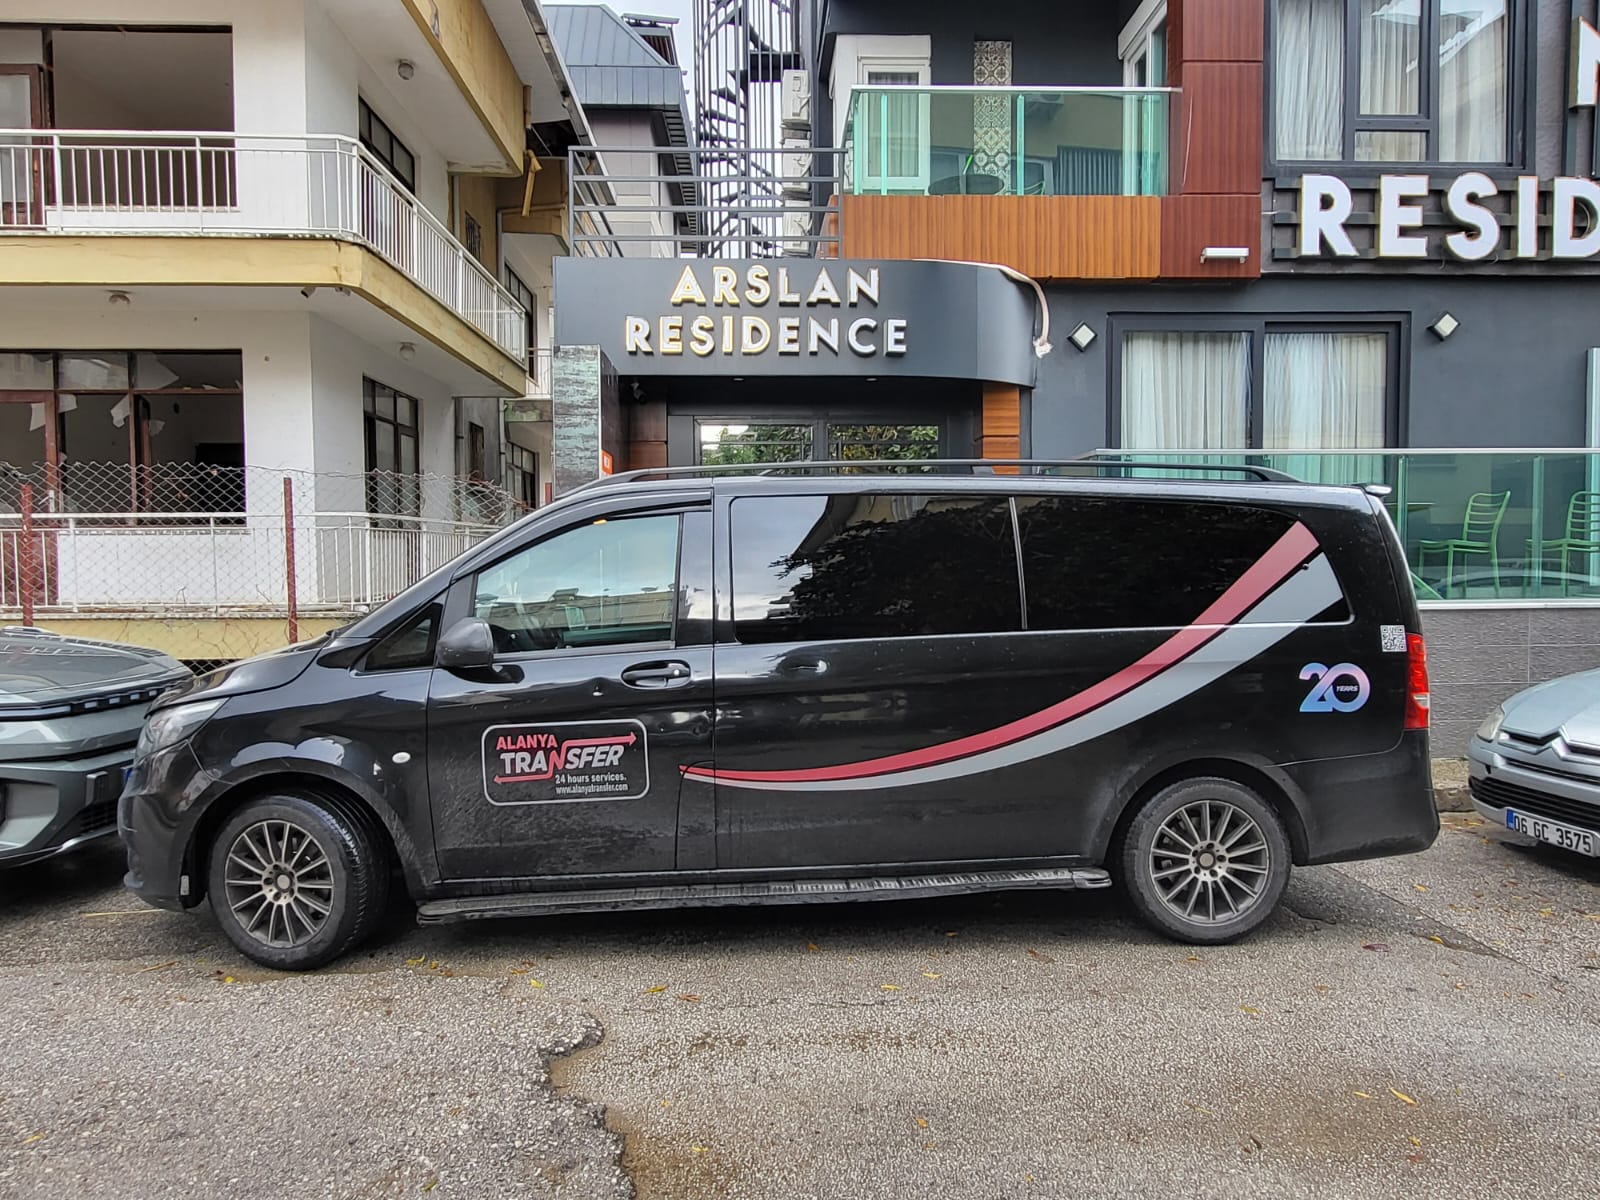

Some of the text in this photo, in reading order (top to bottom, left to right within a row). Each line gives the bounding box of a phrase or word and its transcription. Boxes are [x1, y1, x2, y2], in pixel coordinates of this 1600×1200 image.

[670, 264, 880, 306] ARSLAN
[625, 314, 908, 356] RESIDENCE
[1299, 662, 1371, 713] 20
[496, 734, 558, 751] ALANYA
[500, 744, 624, 775] TRANSFER
[555, 774, 566, 784] 24
[567, 773, 589, 784] hours
[555, 782, 629, 795] www.alanyatransfer.com
[1513, 815, 1592, 854] 06 GC 3575
